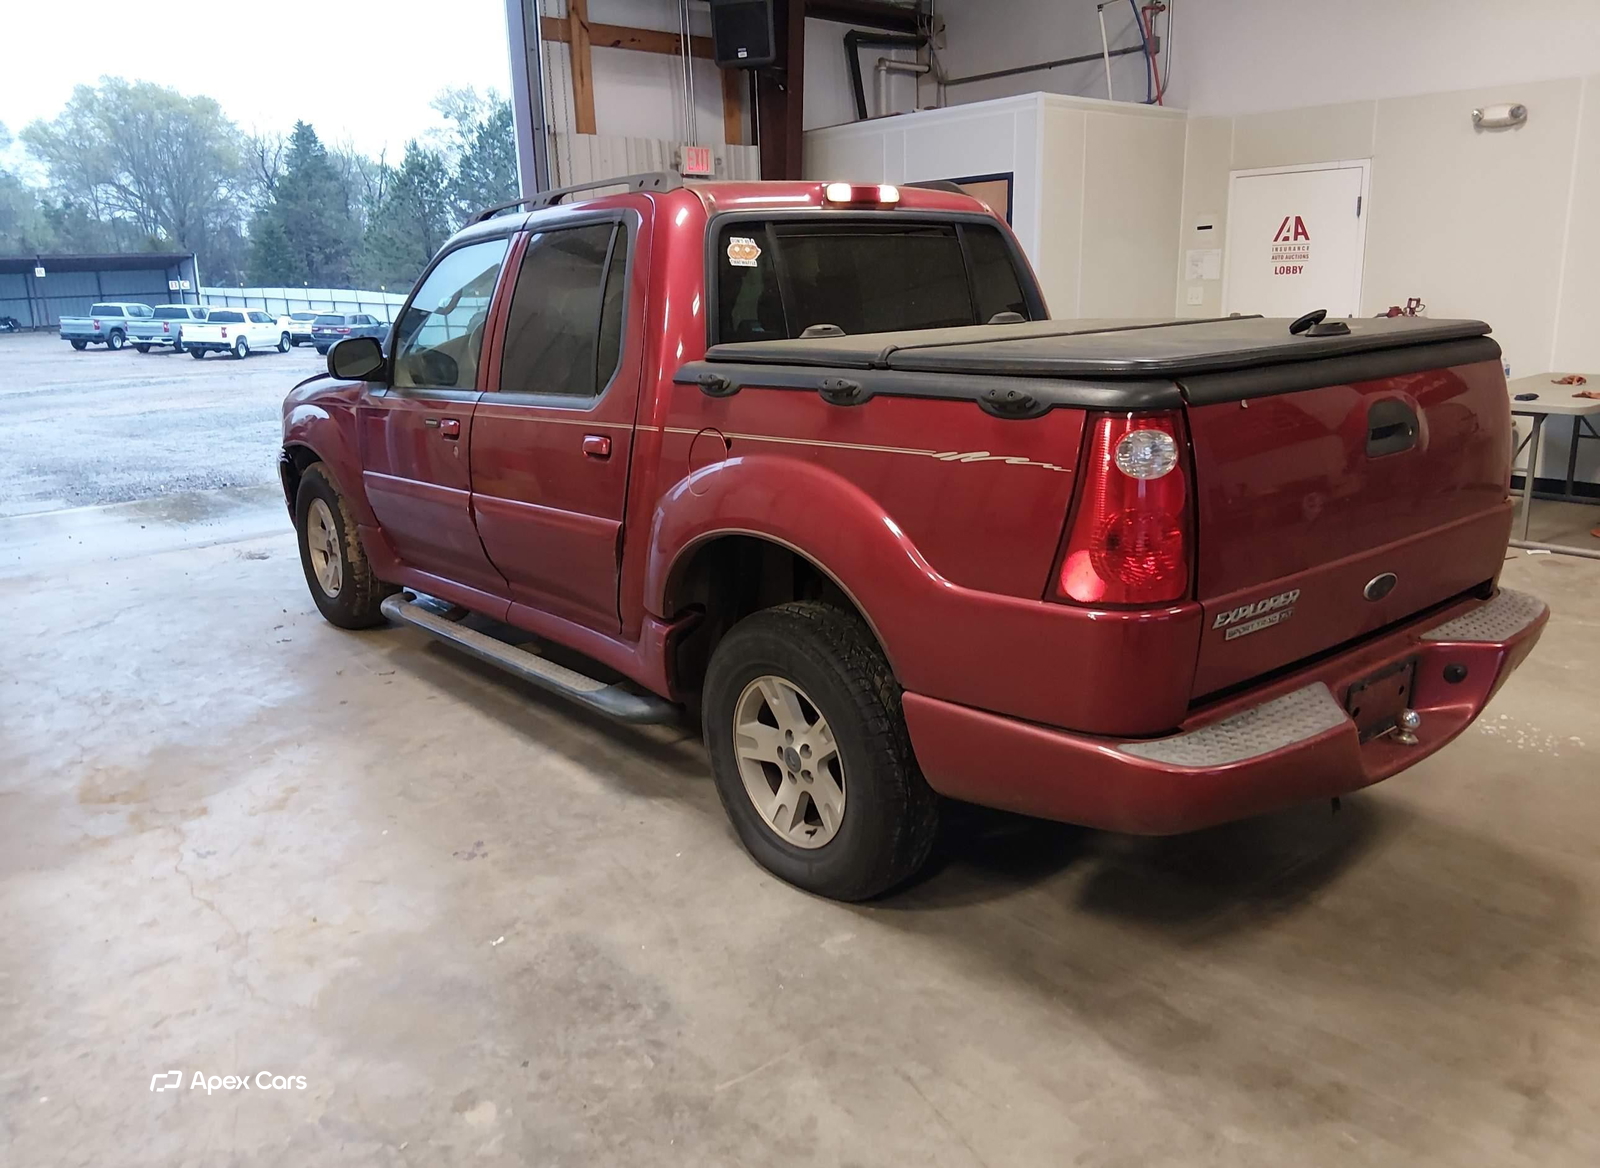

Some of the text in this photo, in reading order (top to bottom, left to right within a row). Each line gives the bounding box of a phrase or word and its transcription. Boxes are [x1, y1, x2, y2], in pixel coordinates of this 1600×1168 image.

[687, 147, 710, 171] EXIT
[1274, 265, 1304, 275] LOBBY
[1212, 588, 1300, 630] EXPLORER
[1227, 623, 1255, 638] SPORT
[1256, 615, 1278, 628] TRAC
